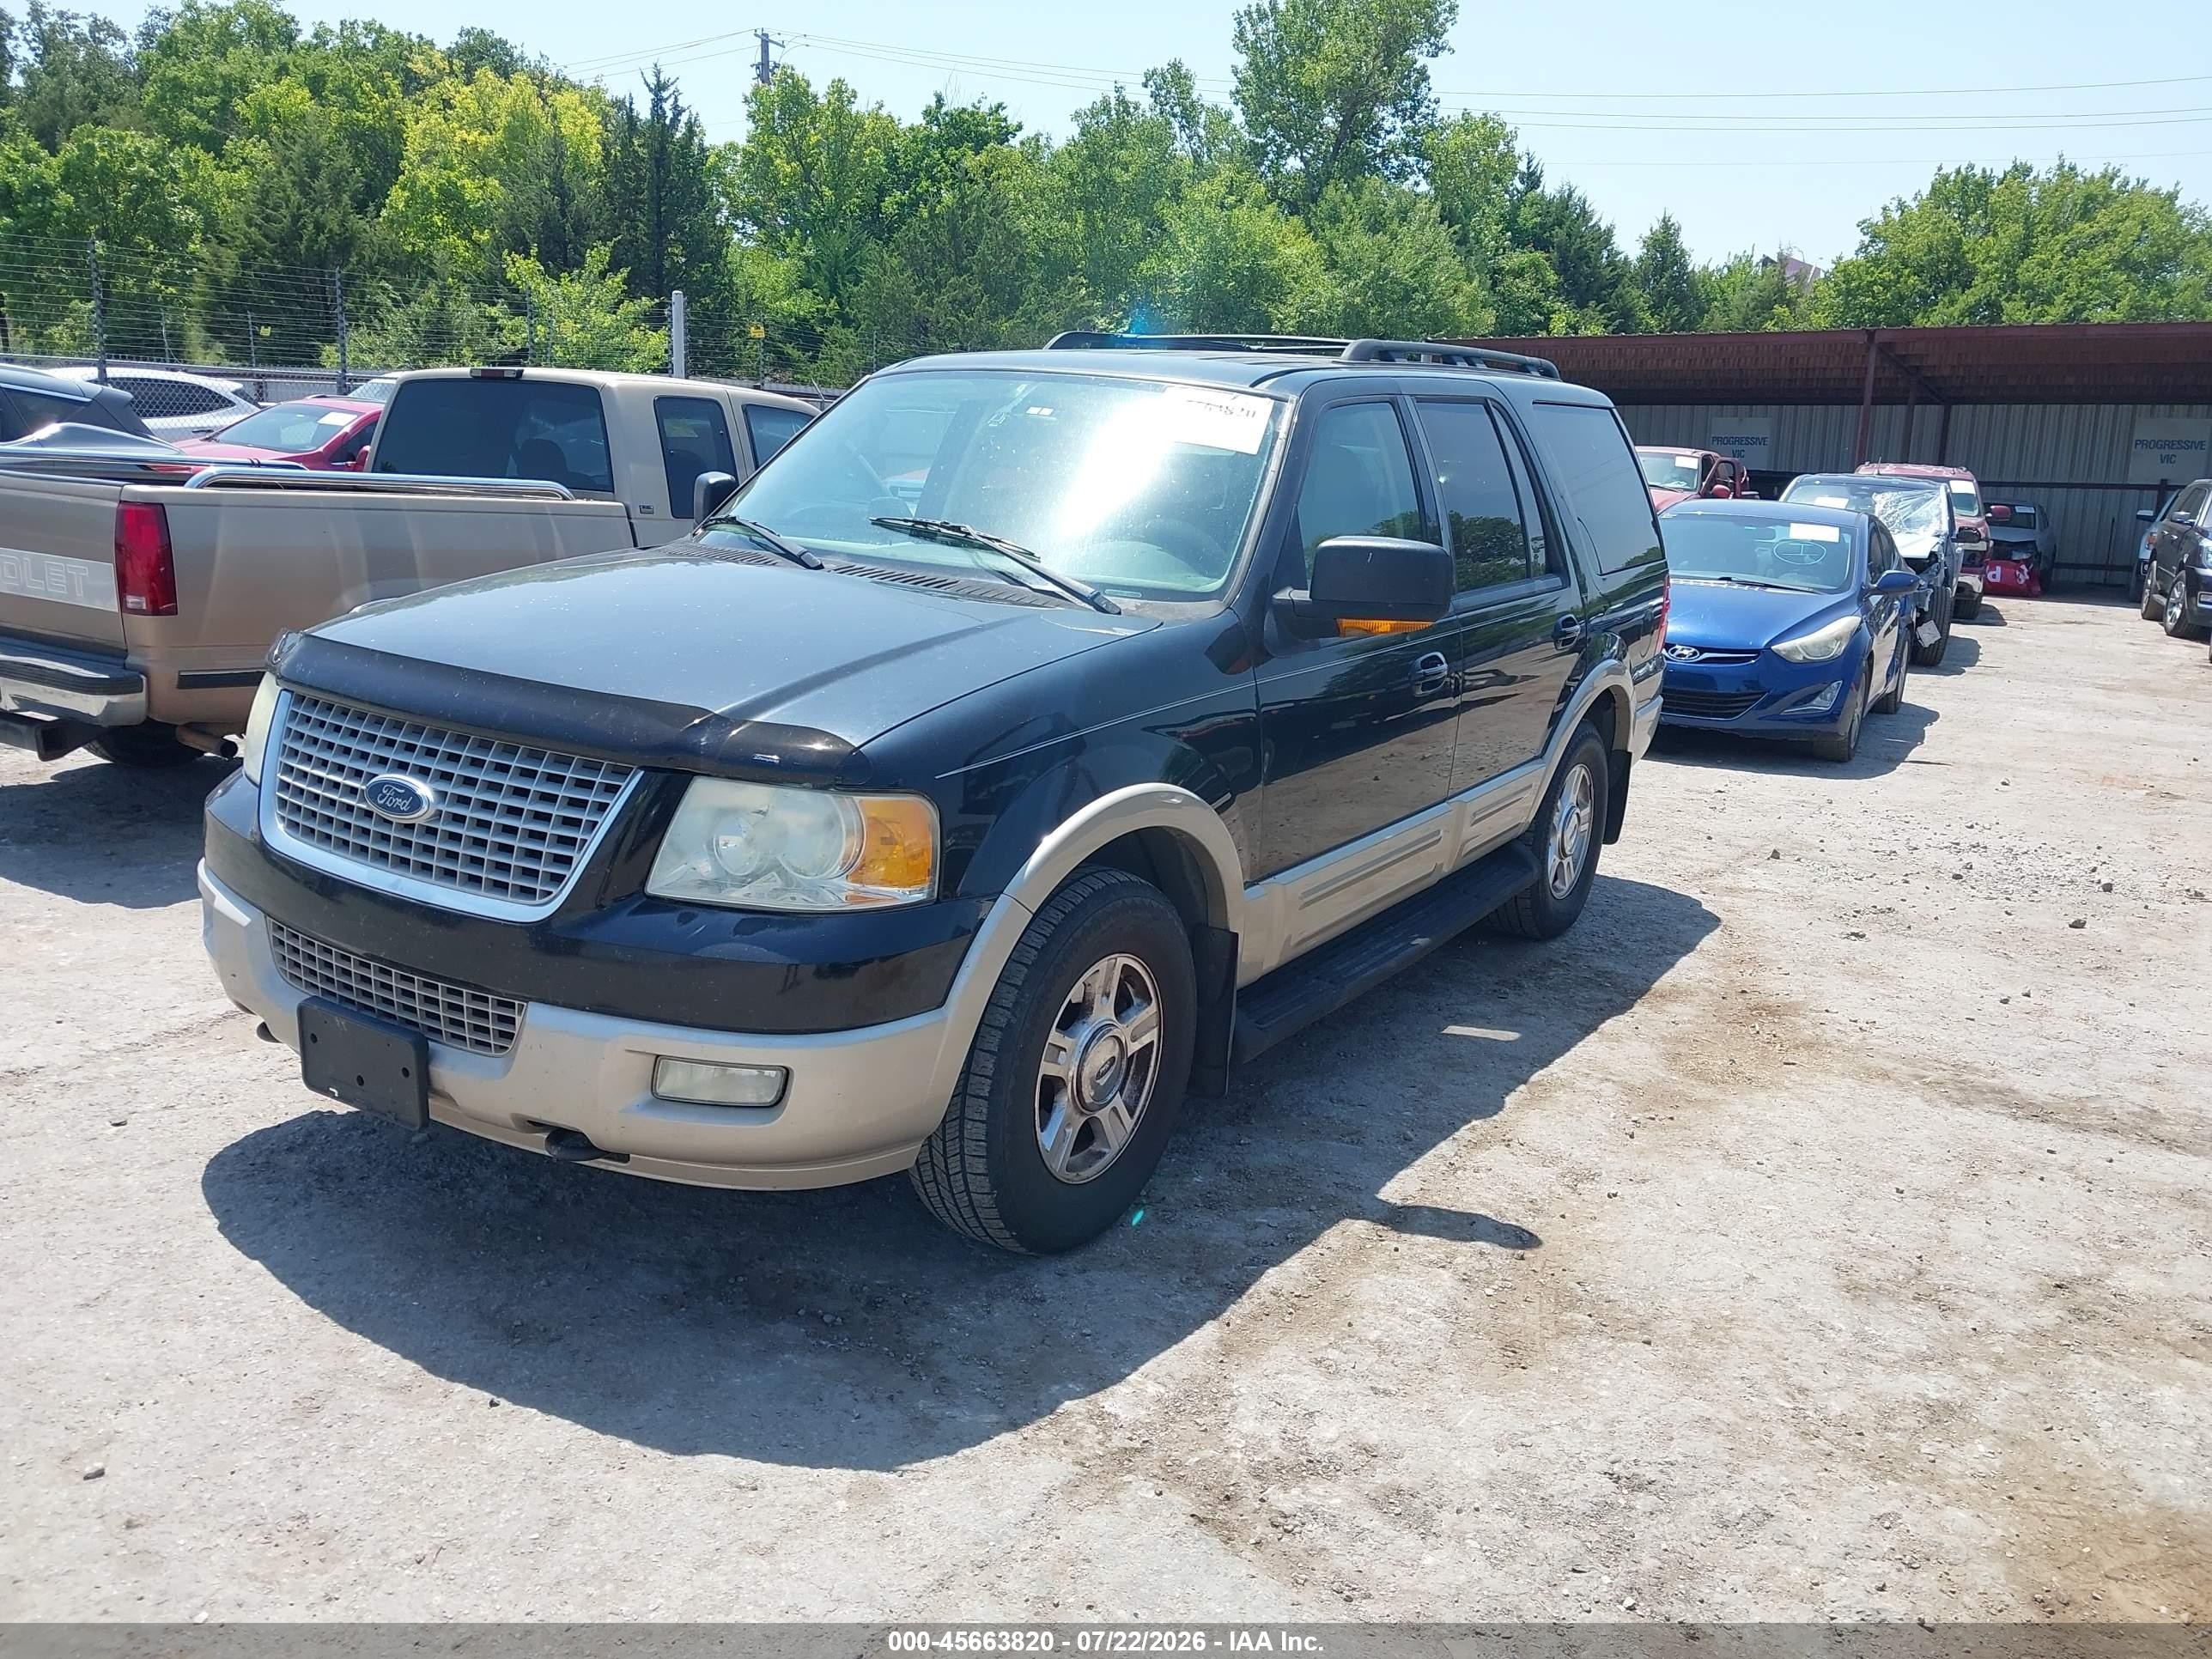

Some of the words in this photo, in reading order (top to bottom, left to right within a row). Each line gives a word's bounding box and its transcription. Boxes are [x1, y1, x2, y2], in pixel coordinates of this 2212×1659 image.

[1711, 436, 1768, 446] PROGRESSIVE
[2135, 439, 2206, 450] PROGRESSIVE
[1732, 449, 1745, 458] VIC
[2160, 453, 2177, 465] VIC
[377, 784, 413, 811] Ford
